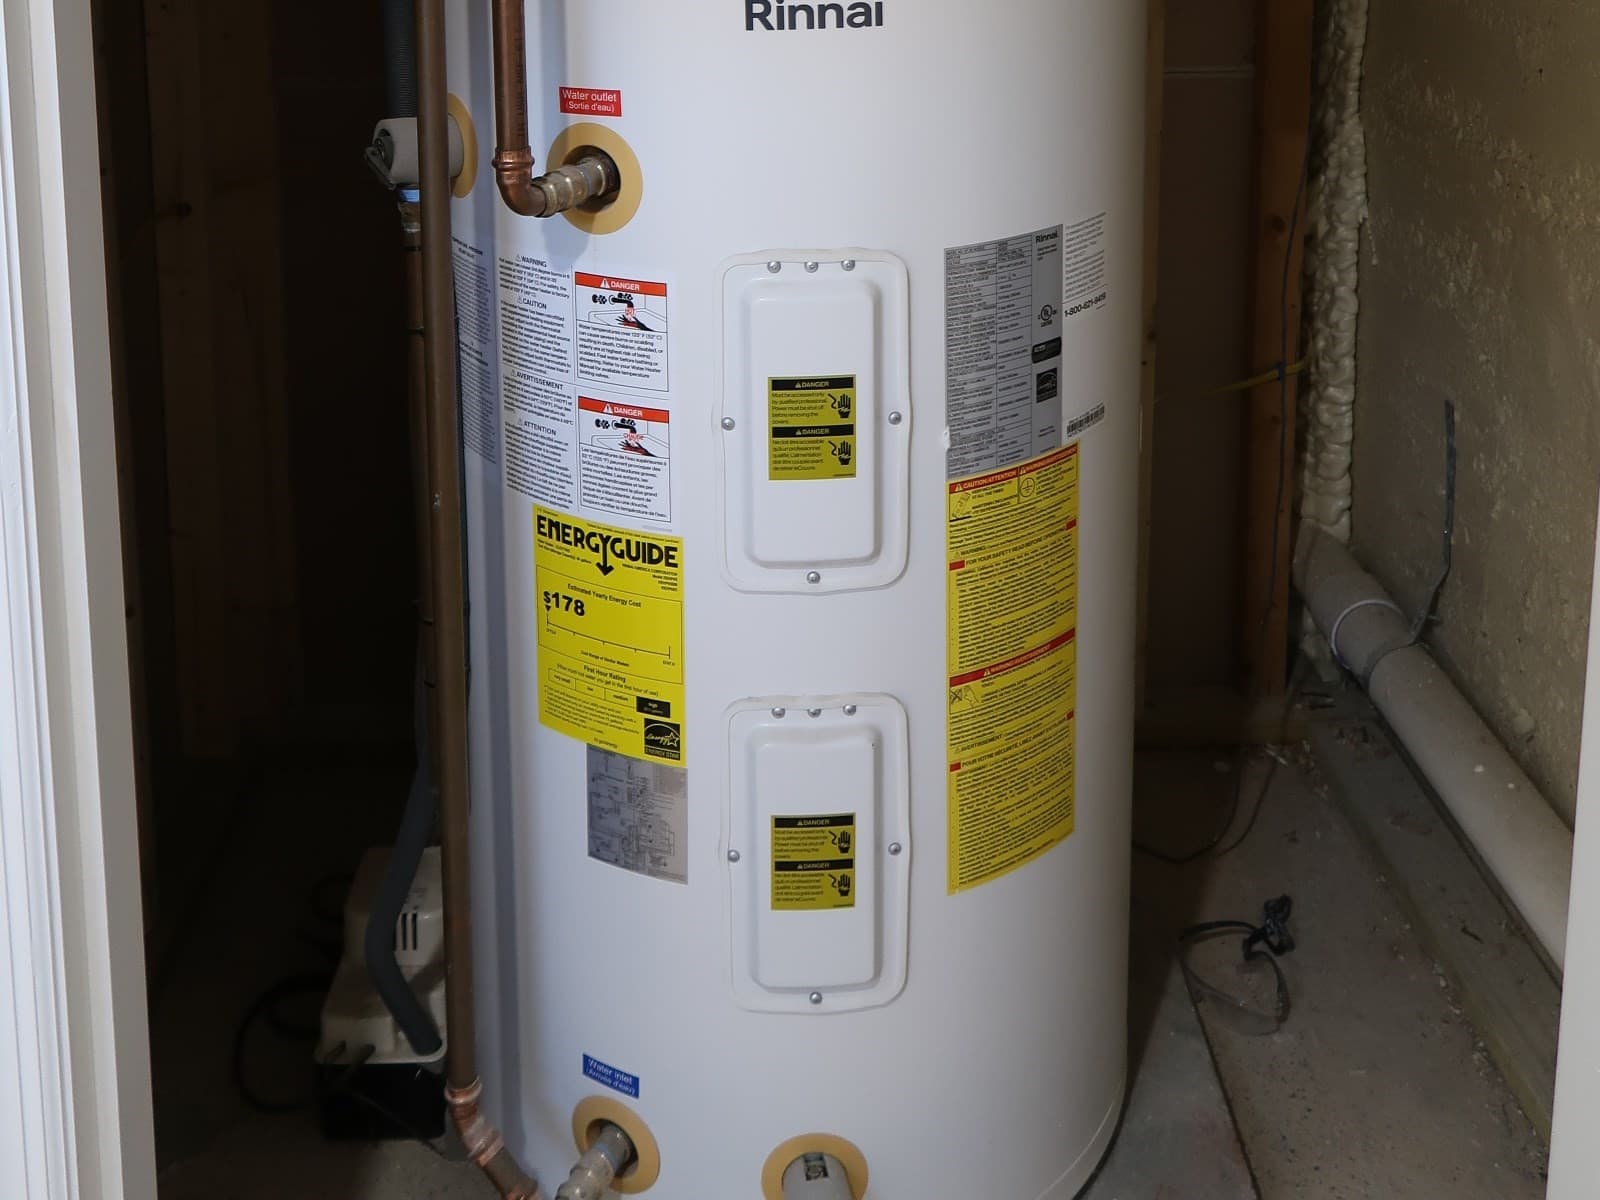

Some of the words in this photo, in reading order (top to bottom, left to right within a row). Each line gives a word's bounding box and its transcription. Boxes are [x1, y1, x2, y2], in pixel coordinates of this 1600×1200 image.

[562, 89, 588, 101] Water
[591, 92, 617, 102] outlet
[521, 256, 547, 267] WARNING
[611, 281, 640, 291] DANGER
[523, 298, 547, 309] CAUTION
[516, 372, 563, 390] AVERTISSEMENT
[614, 407, 642, 416] DANGER
[524, 421, 556, 435] ATTENTION
[537, 514, 678, 569] ENERGYGUIDE
[567, 584, 592, 596] Estimated
[593, 591, 608, 601] Yearly
[609, 595, 627, 606] Energy
[629, 600, 641, 608] Cost
[543, 591, 585, 617] $178
[584, 664, 595, 673] First
[596, 668, 608, 677] Hour
[609, 672, 626, 682] Rating
